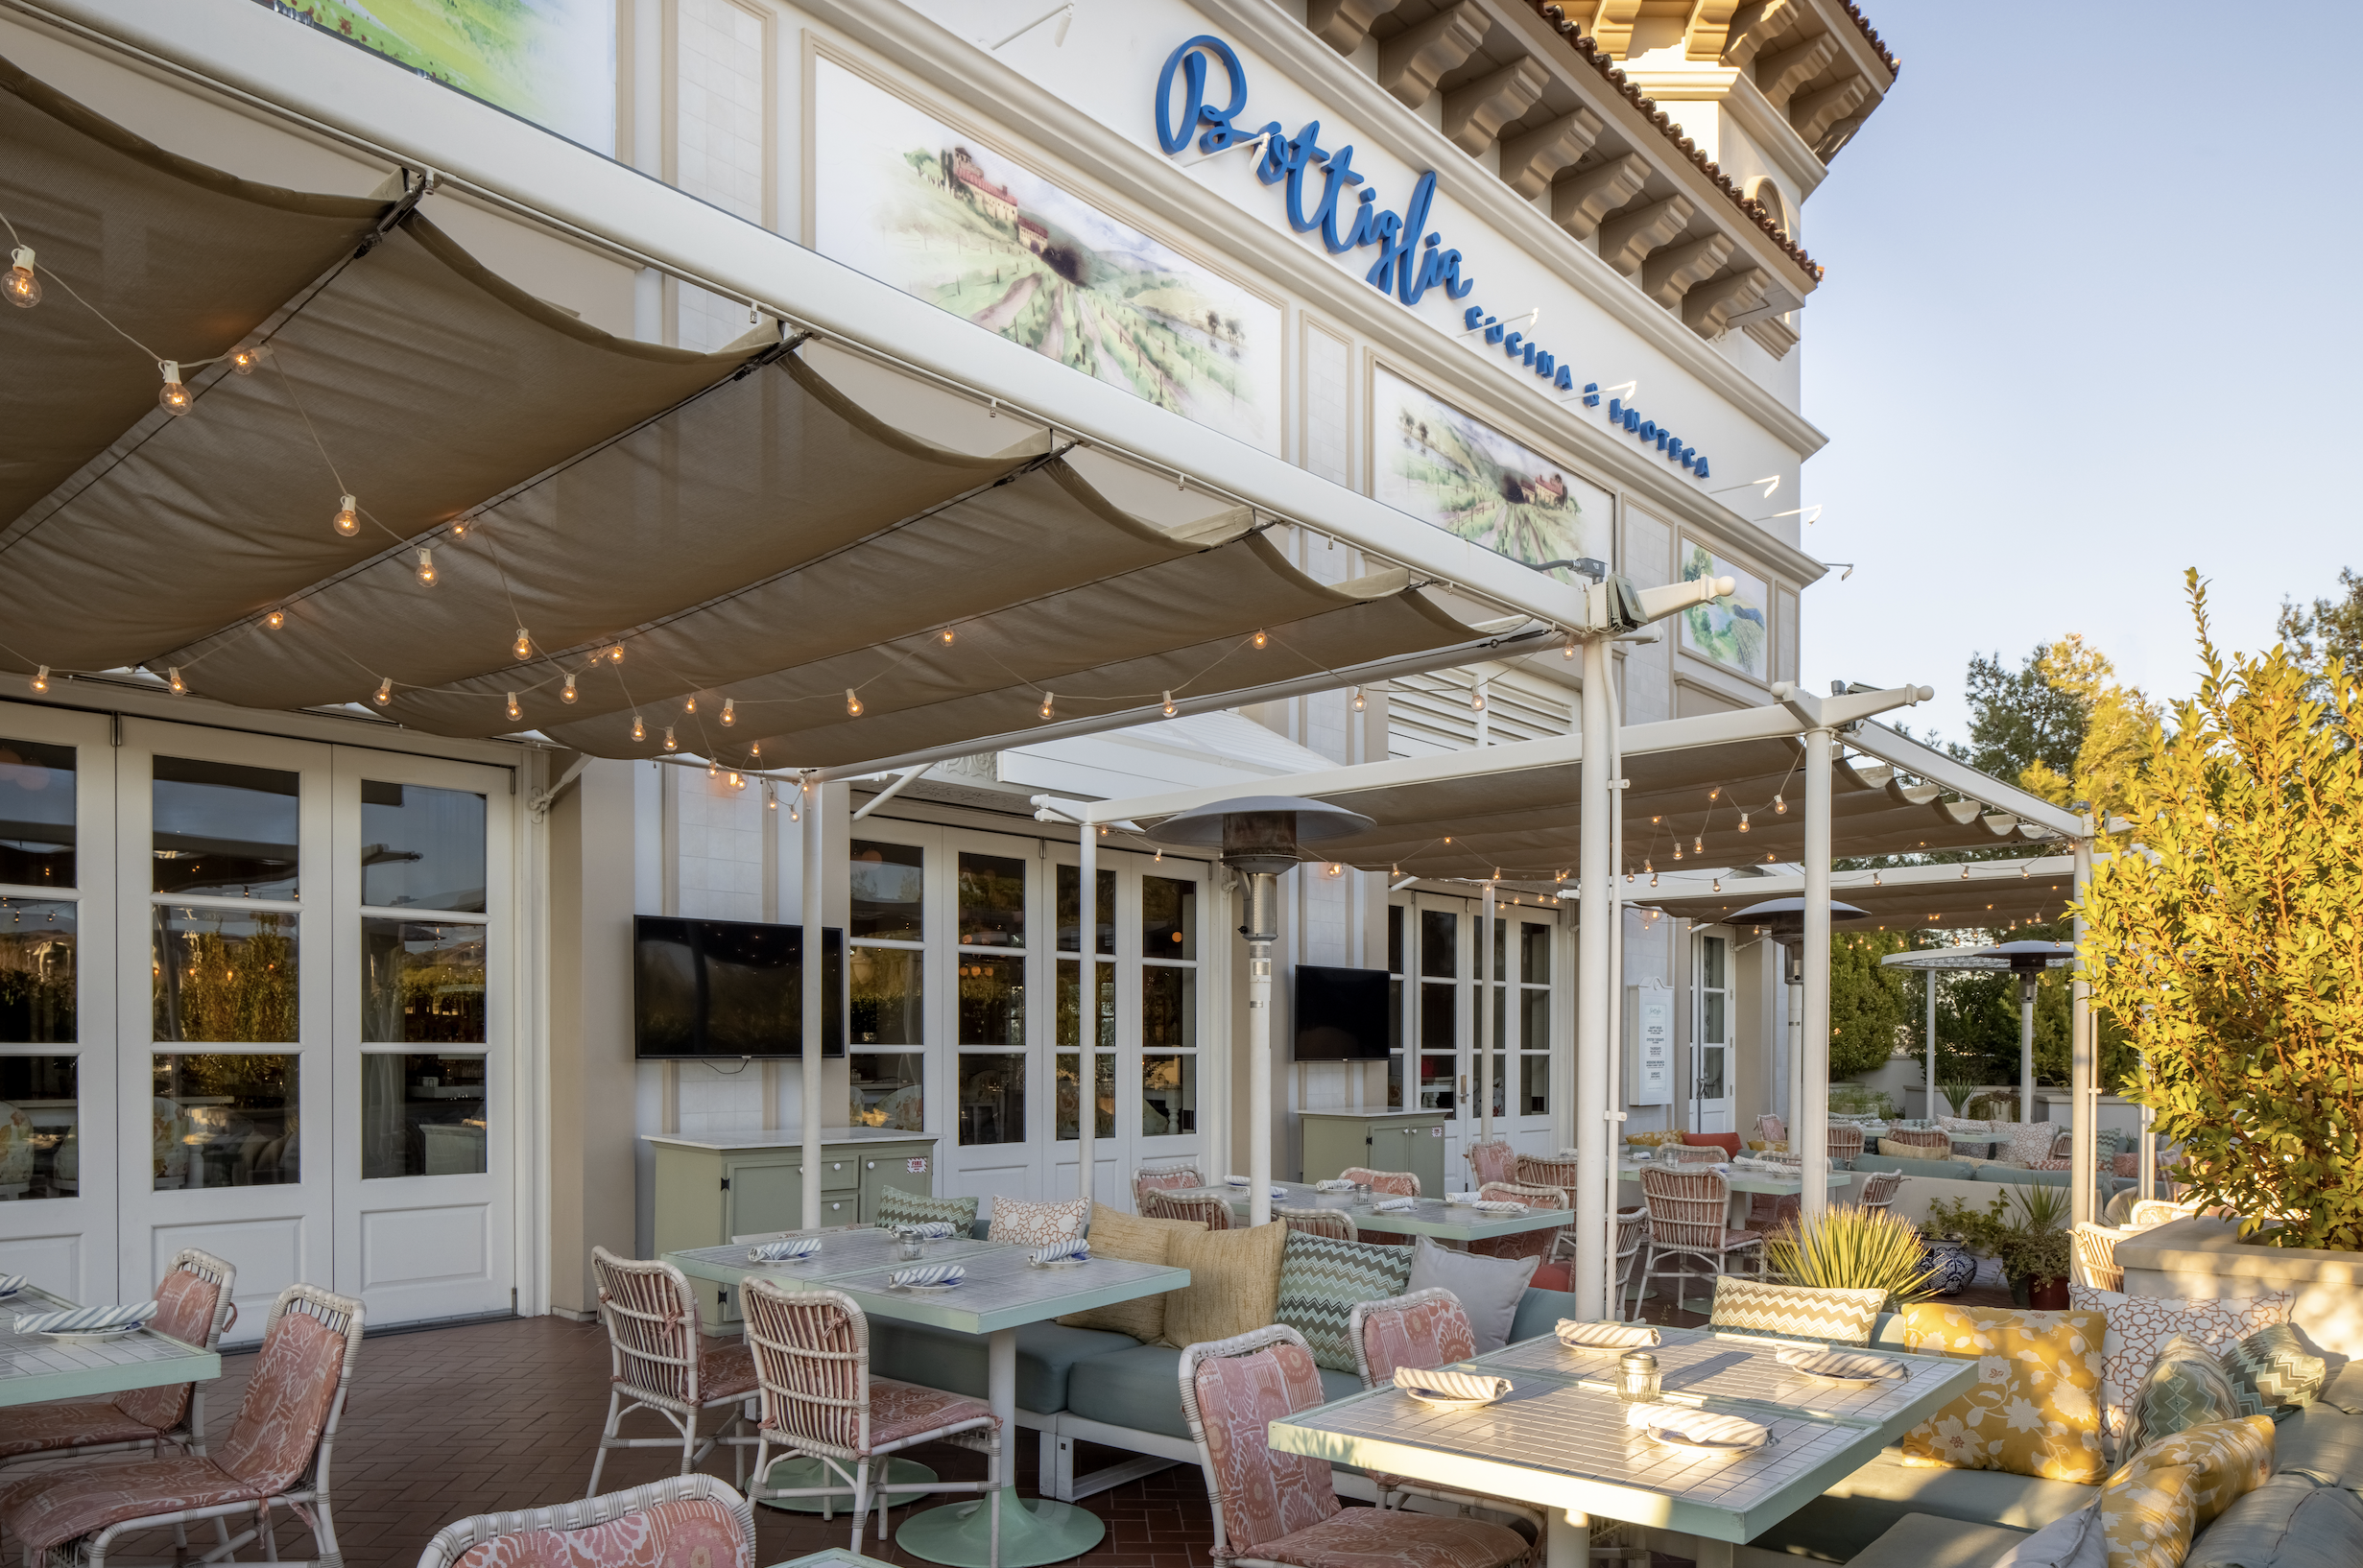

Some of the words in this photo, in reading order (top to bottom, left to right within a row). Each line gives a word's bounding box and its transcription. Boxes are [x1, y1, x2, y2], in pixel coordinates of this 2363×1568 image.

[1155, 35, 1474, 306] Bottiglia
[1465, 305, 1573, 391] CUCINA
[1583, 382, 1600, 408] &
[1610, 398, 1710, 479] ENOTECA
